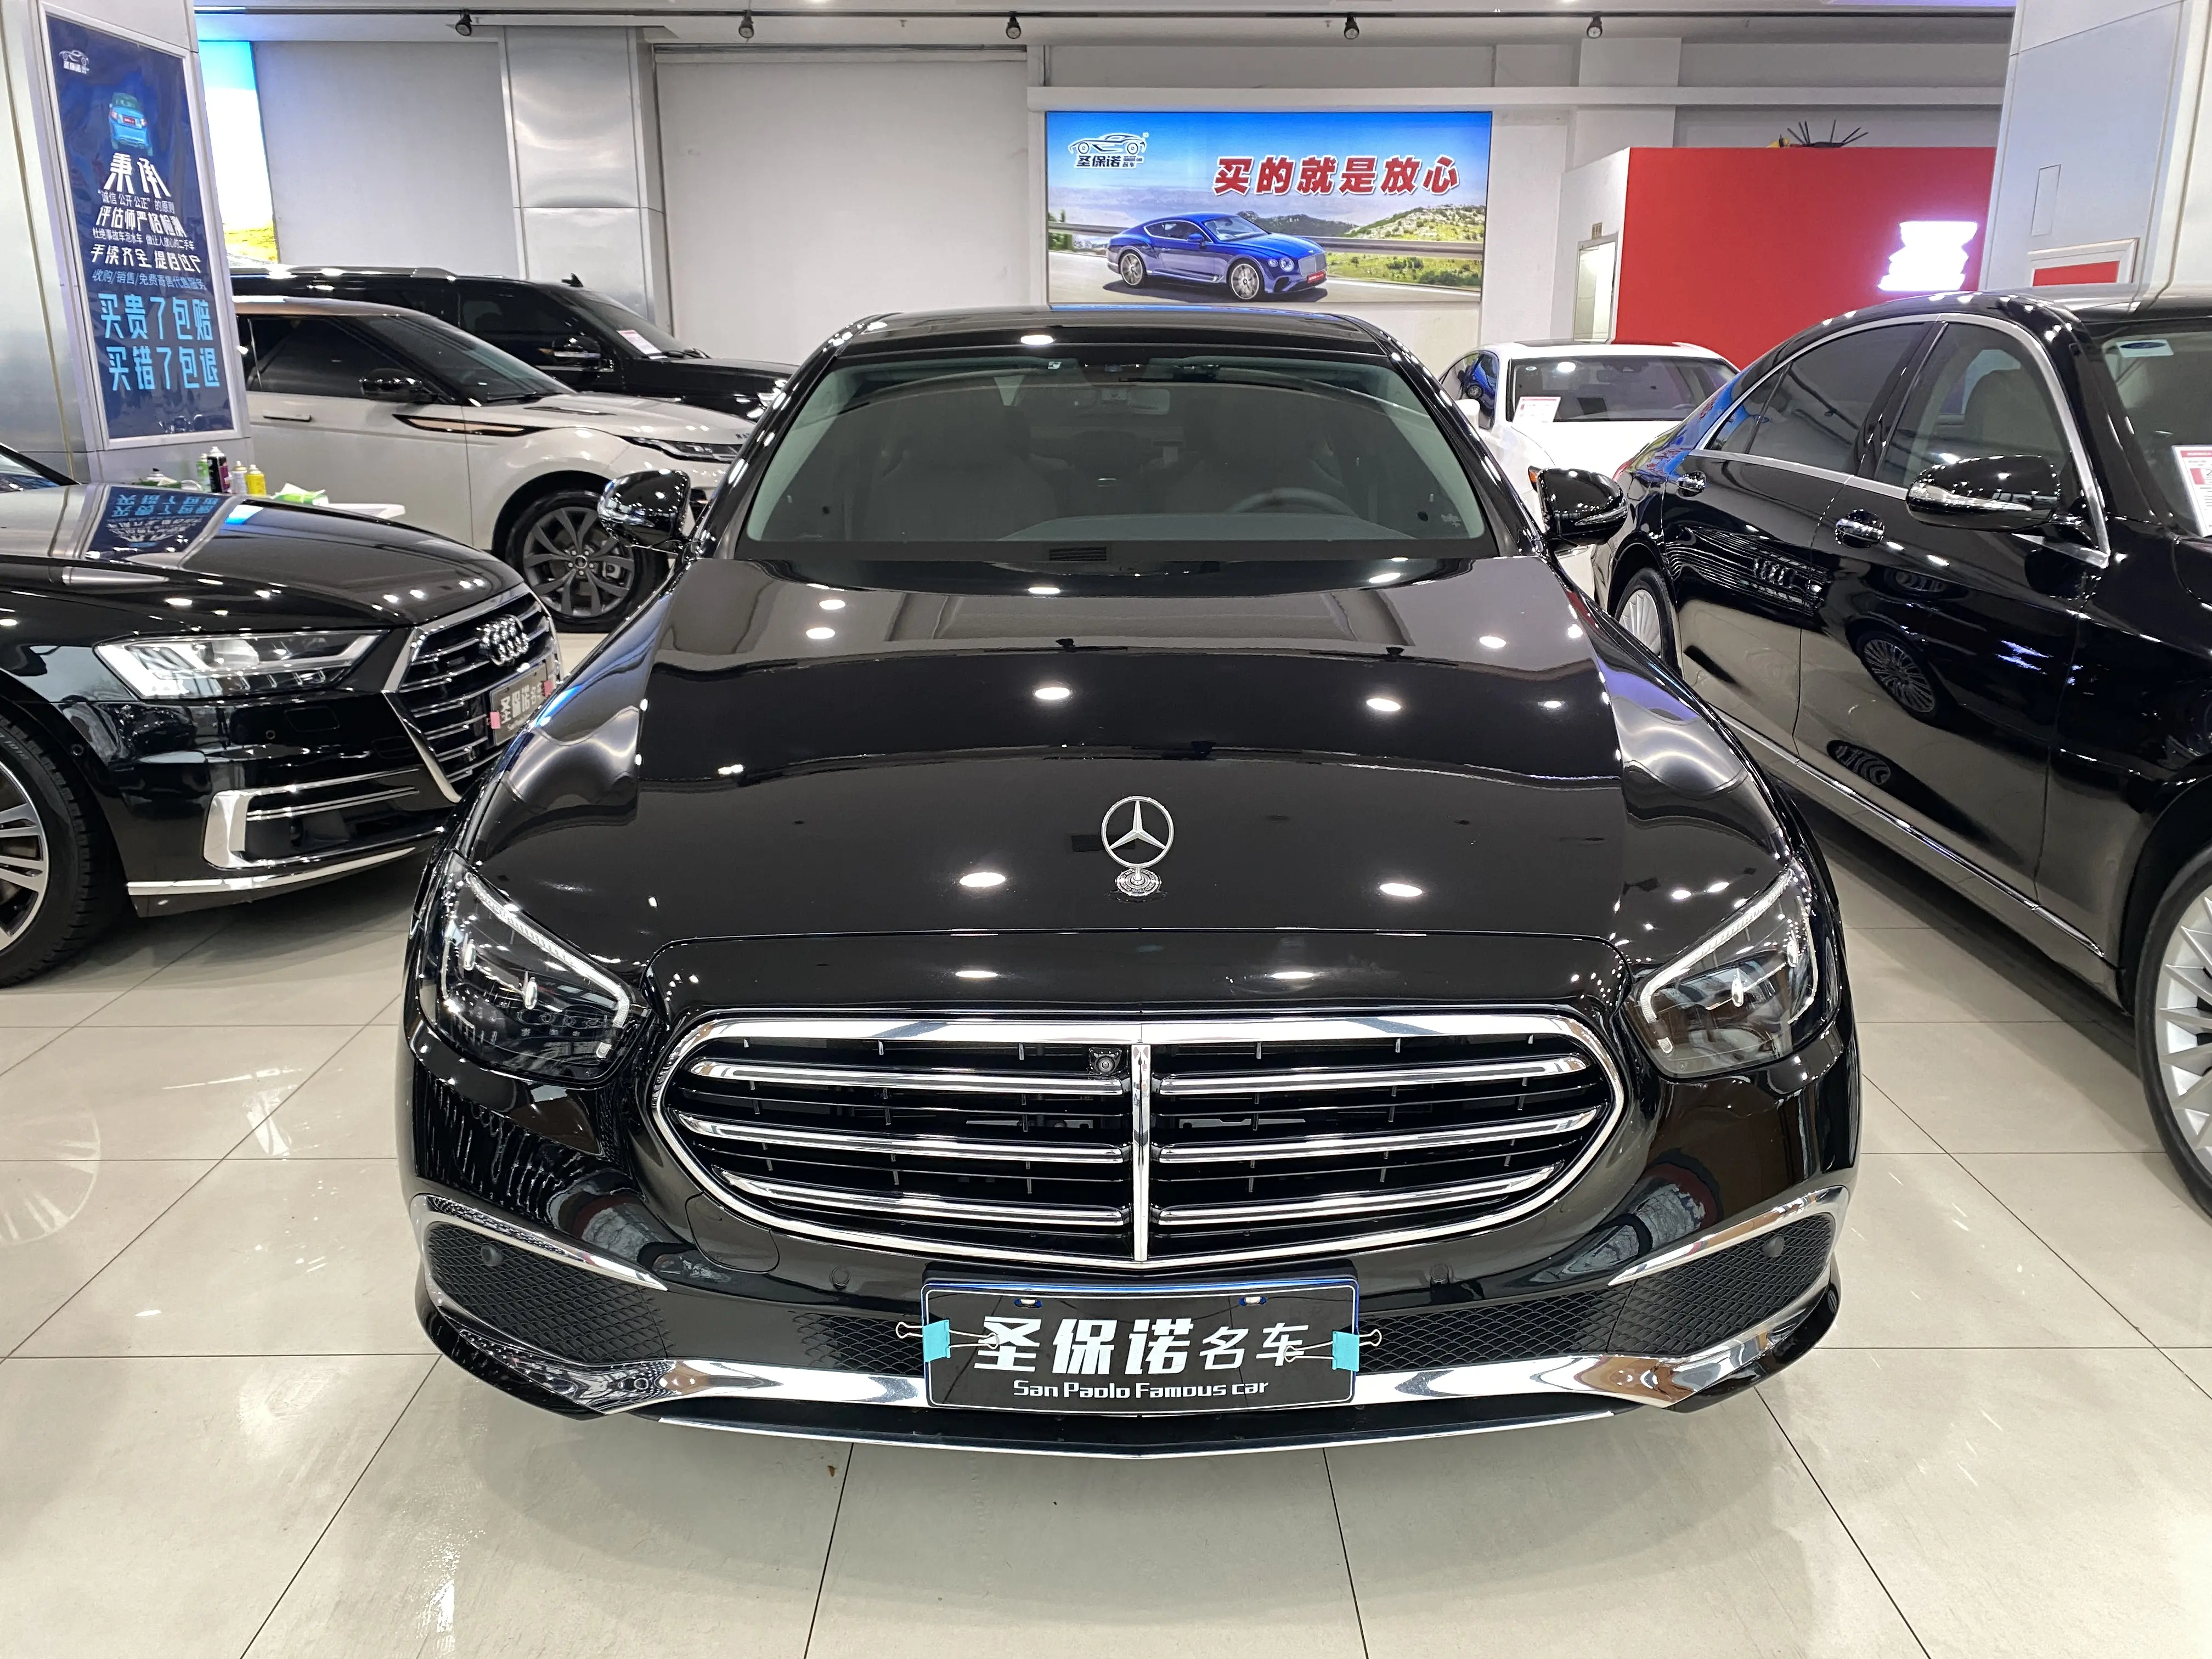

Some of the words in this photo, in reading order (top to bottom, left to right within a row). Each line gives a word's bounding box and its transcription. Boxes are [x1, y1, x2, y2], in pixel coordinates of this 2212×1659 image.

[104, 153, 171, 199] 秉承
[1076, 155, 1121, 167] 圣保诺
[1213, 155, 1459, 195] 买的就是放心
[96, 205, 187, 238] 评估师严格检测
[91, 244, 152, 268] 手续齐全
[154, 250, 201, 273] 提档过户
[98, 293, 213, 340] 买贵了包赔
[106, 346, 220, 391] 买错了包退
[974, 1316, 1309, 1374] 圣保诺名车
[1013, 1380, 1058, 1398] San
[1064, 1380, 1130, 1399] Paolo
[1135, 1381, 1227, 1399] Famous
[1232, 1380, 1269, 1395] car
